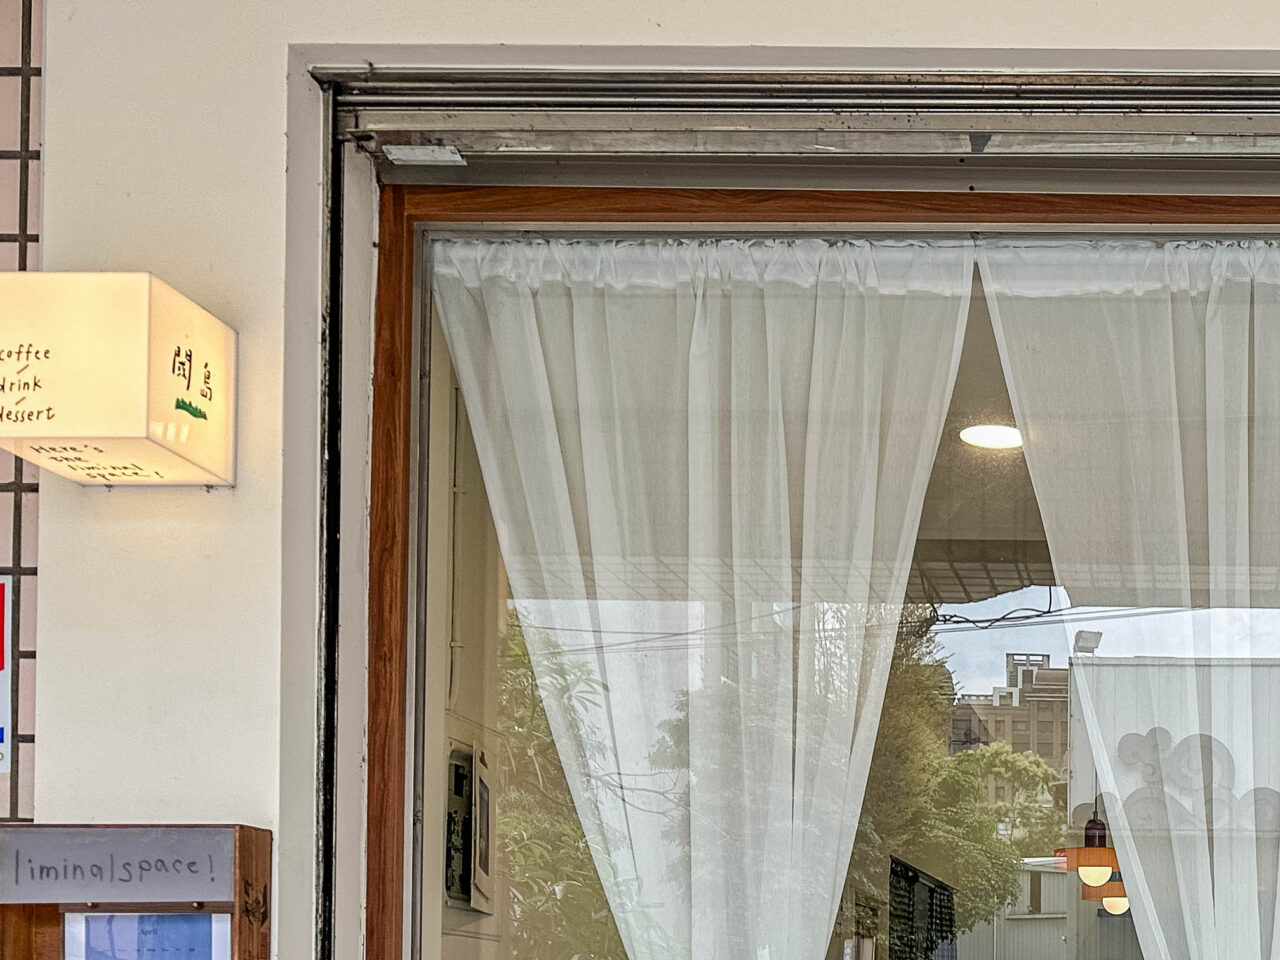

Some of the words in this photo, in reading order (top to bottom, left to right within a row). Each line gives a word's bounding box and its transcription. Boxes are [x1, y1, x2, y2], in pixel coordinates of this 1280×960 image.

[0, 343, 50, 361] coffee
[0, 375, 42, 393] drink
[48, 455, 89, 463] the
